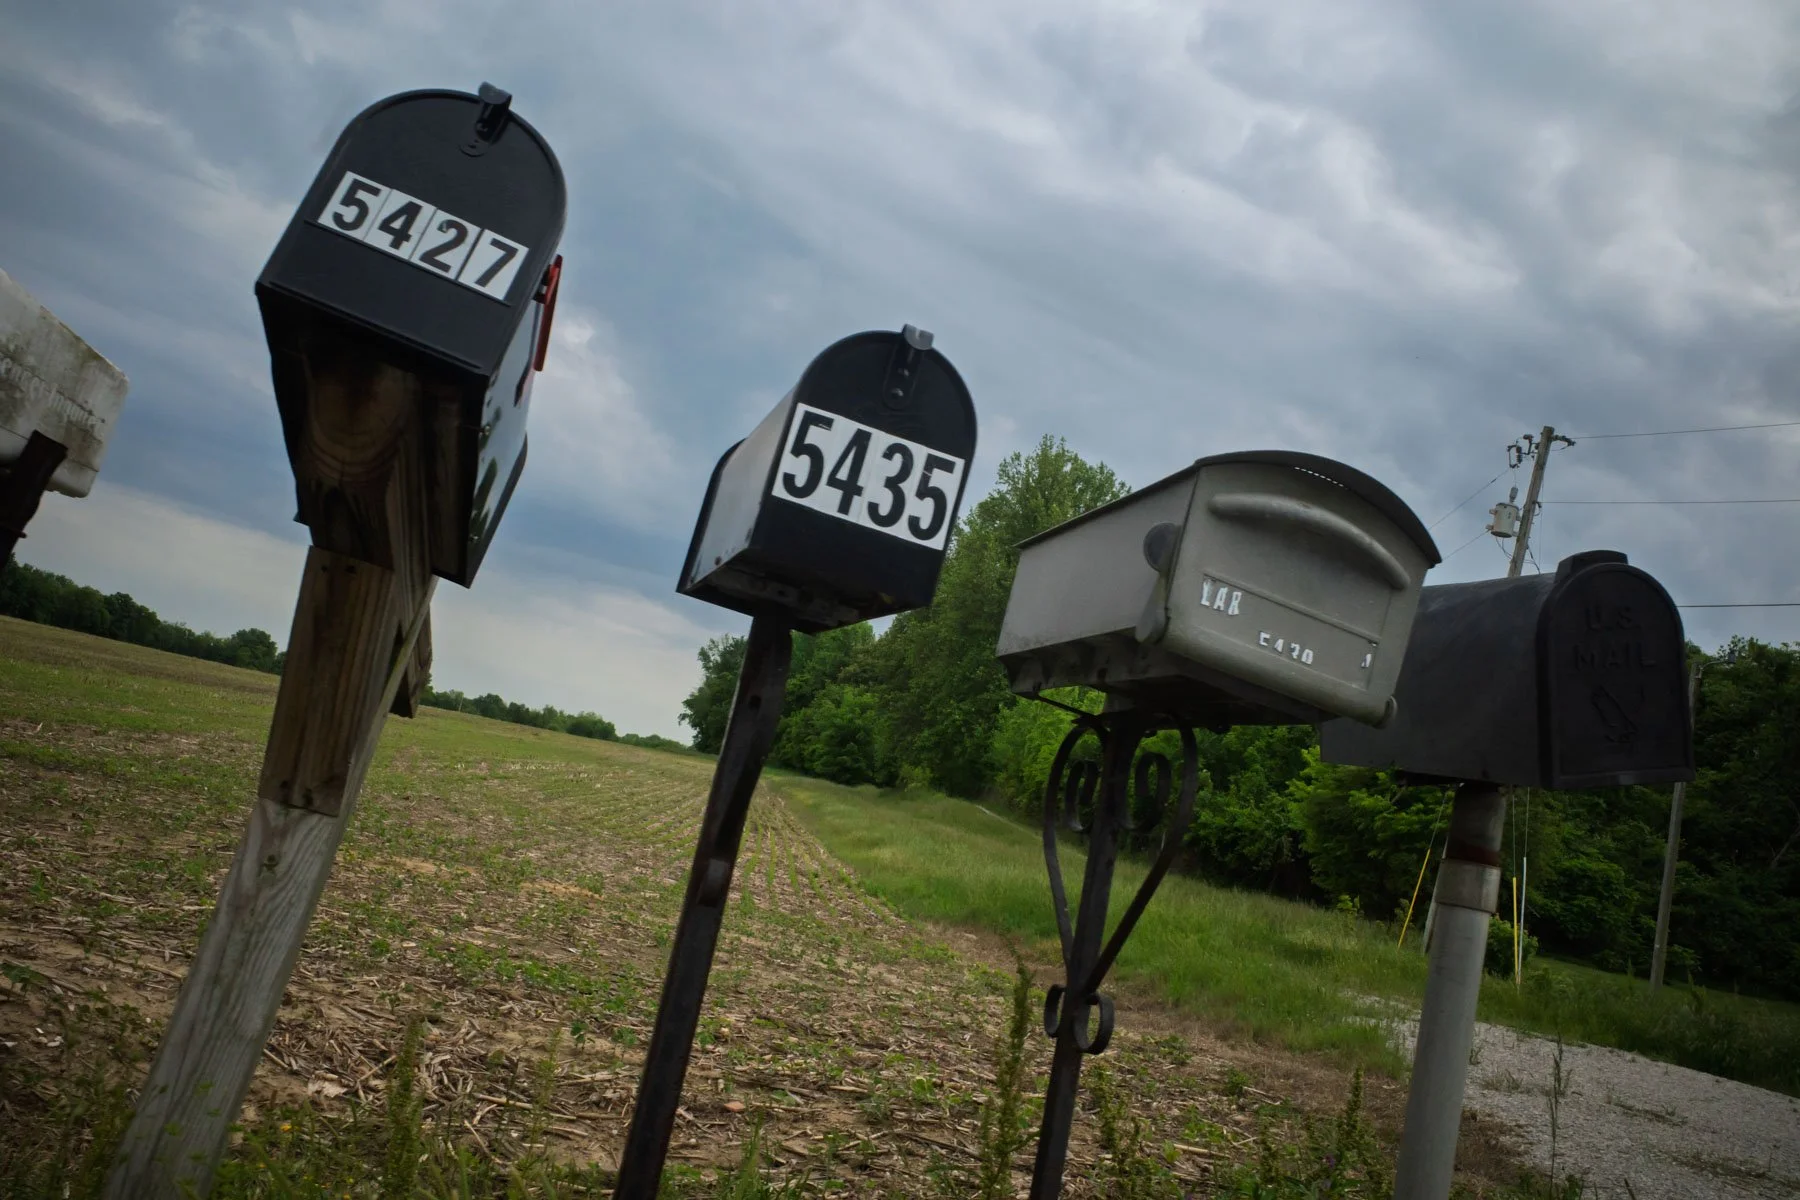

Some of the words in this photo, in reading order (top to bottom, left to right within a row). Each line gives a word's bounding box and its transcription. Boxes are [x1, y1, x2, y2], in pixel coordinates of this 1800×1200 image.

[332, 178, 519, 288] 5427
[783, 410, 956, 540] 5435
[1572, 641, 1657, 671] MAIL
